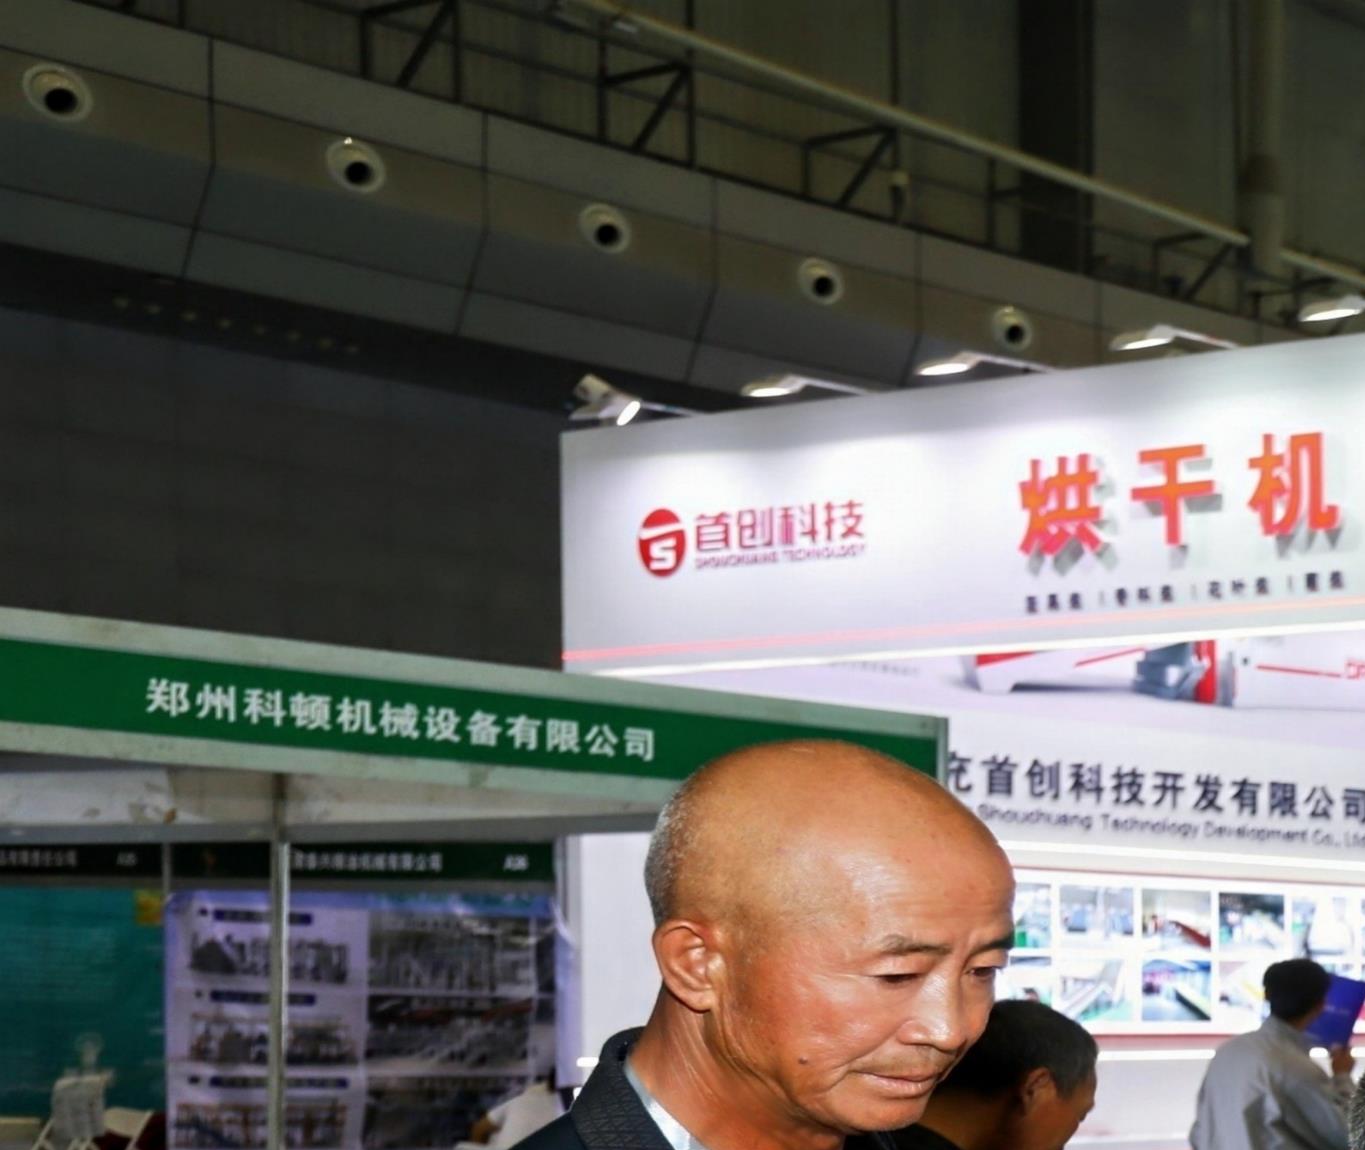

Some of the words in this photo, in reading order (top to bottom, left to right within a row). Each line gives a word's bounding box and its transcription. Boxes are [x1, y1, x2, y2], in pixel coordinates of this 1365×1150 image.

[694, 499, 866, 552] 首创科技
[1017, 431, 1340, 556] 烘干机
[145, 676, 657, 762] 郑州科顿机械设备有限公司
[1102, 812, 1200, 840] Technology
[1204, 821, 1308, 845] Development
